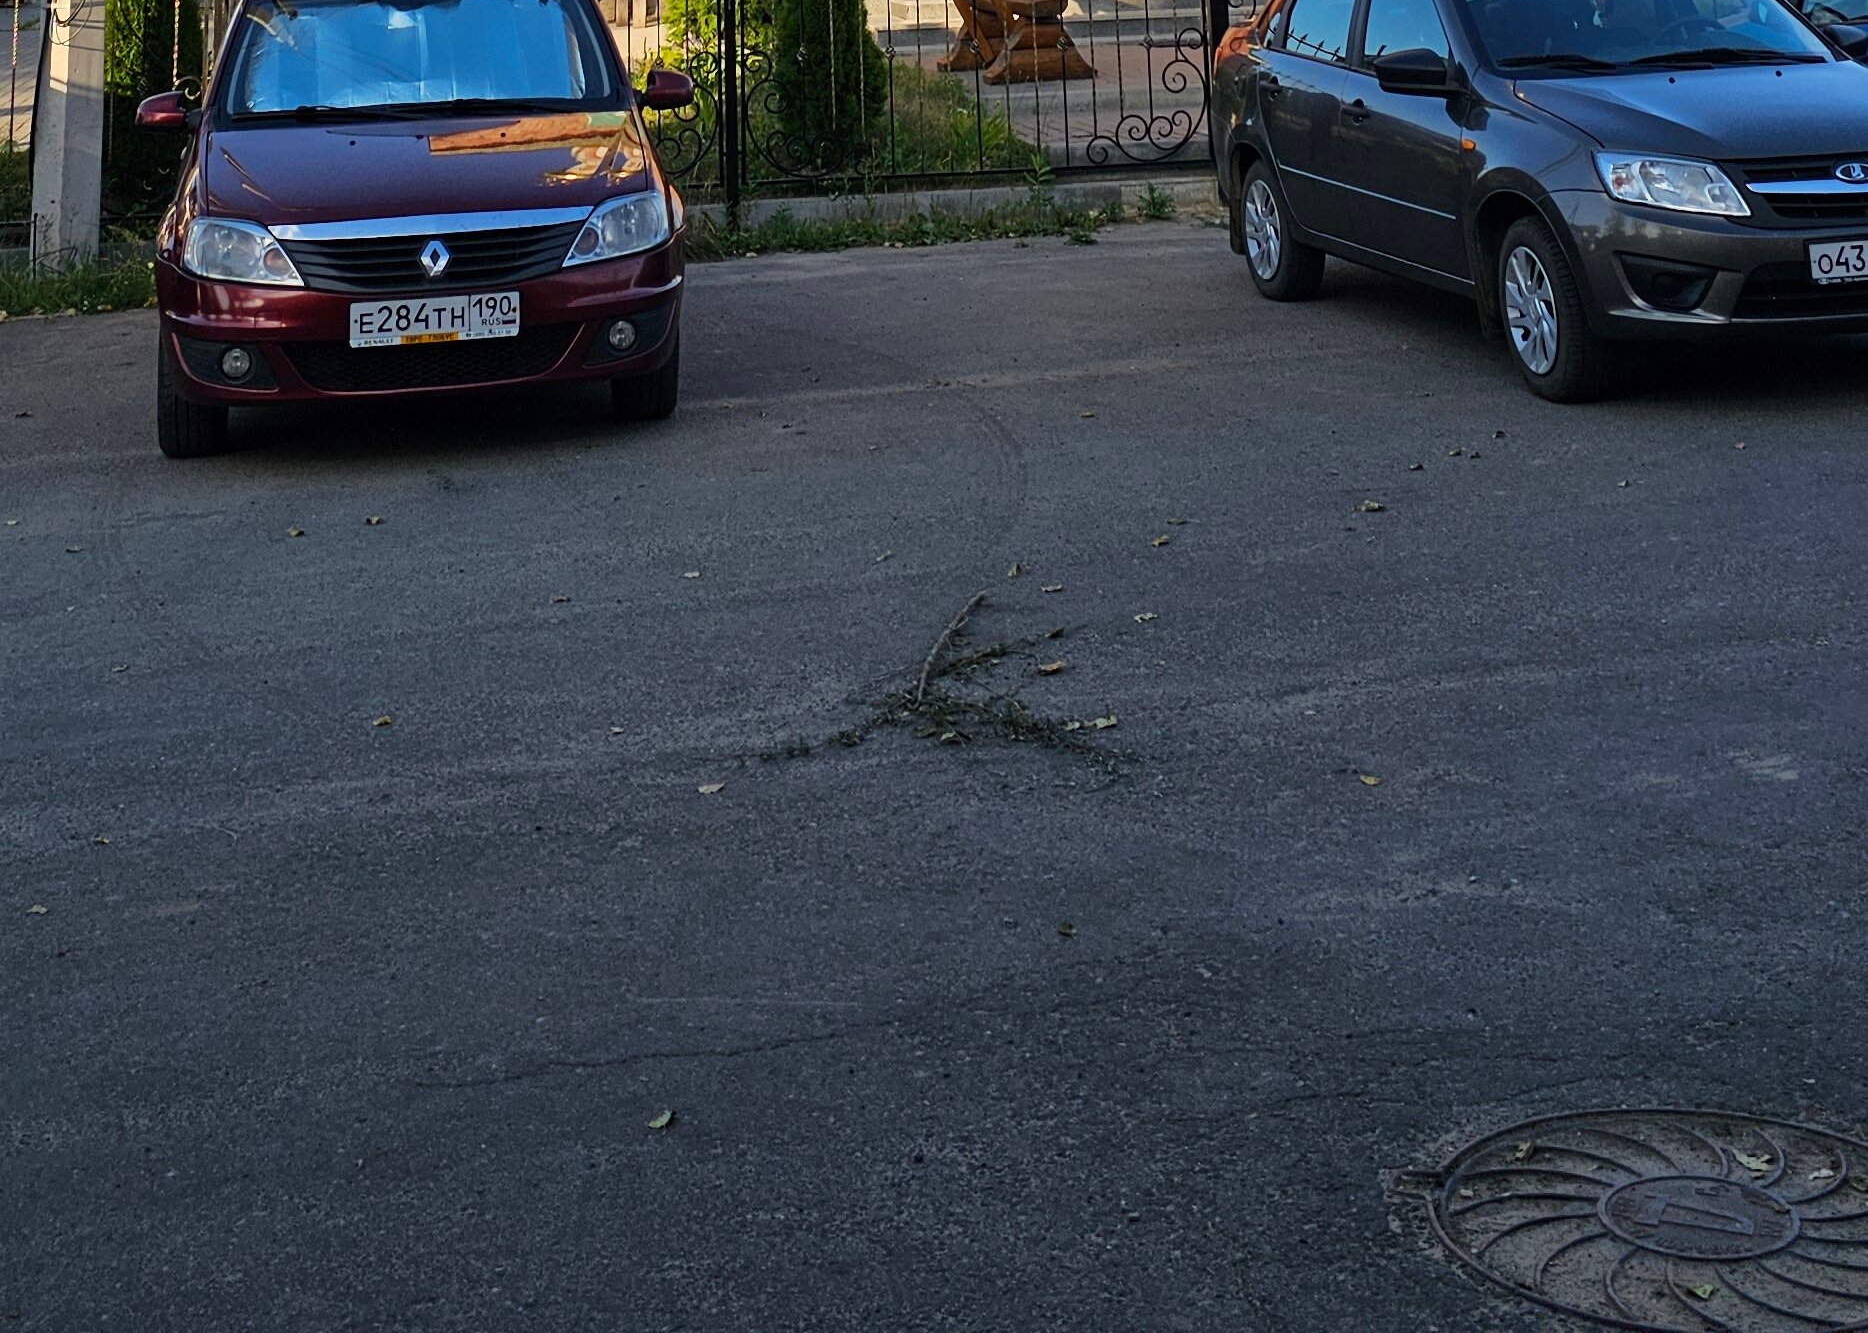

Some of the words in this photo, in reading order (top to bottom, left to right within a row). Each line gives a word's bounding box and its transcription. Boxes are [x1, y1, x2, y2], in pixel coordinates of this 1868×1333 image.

[359, 302, 465, 334] Е284ТН
[472, 295, 512, 318] 190
[481, 317, 502, 326] RUS
